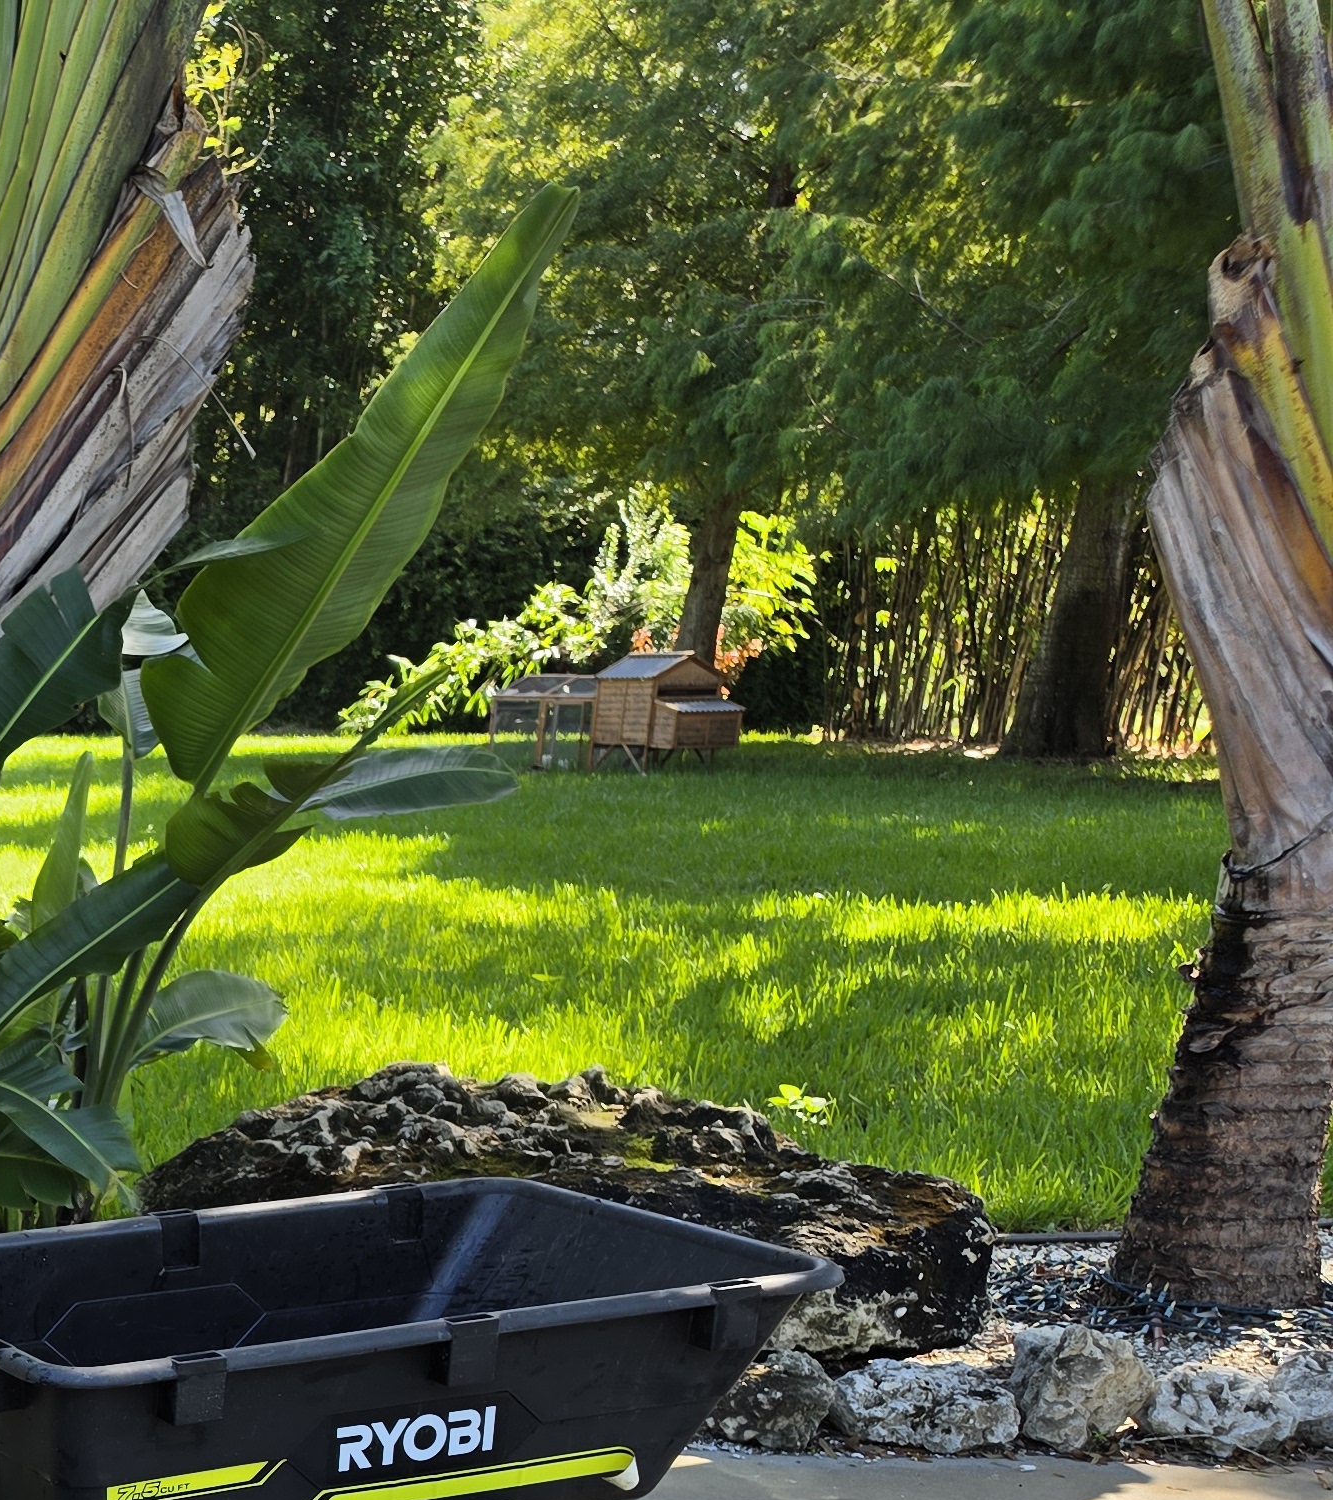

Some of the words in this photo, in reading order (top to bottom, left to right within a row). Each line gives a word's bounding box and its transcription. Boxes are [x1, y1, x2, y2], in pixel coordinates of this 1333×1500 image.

[337, 1405, 495, 1472] RYOBI
[160, 1486, 175, 1494] CU
[177, 1483, 191, 1491] FT
